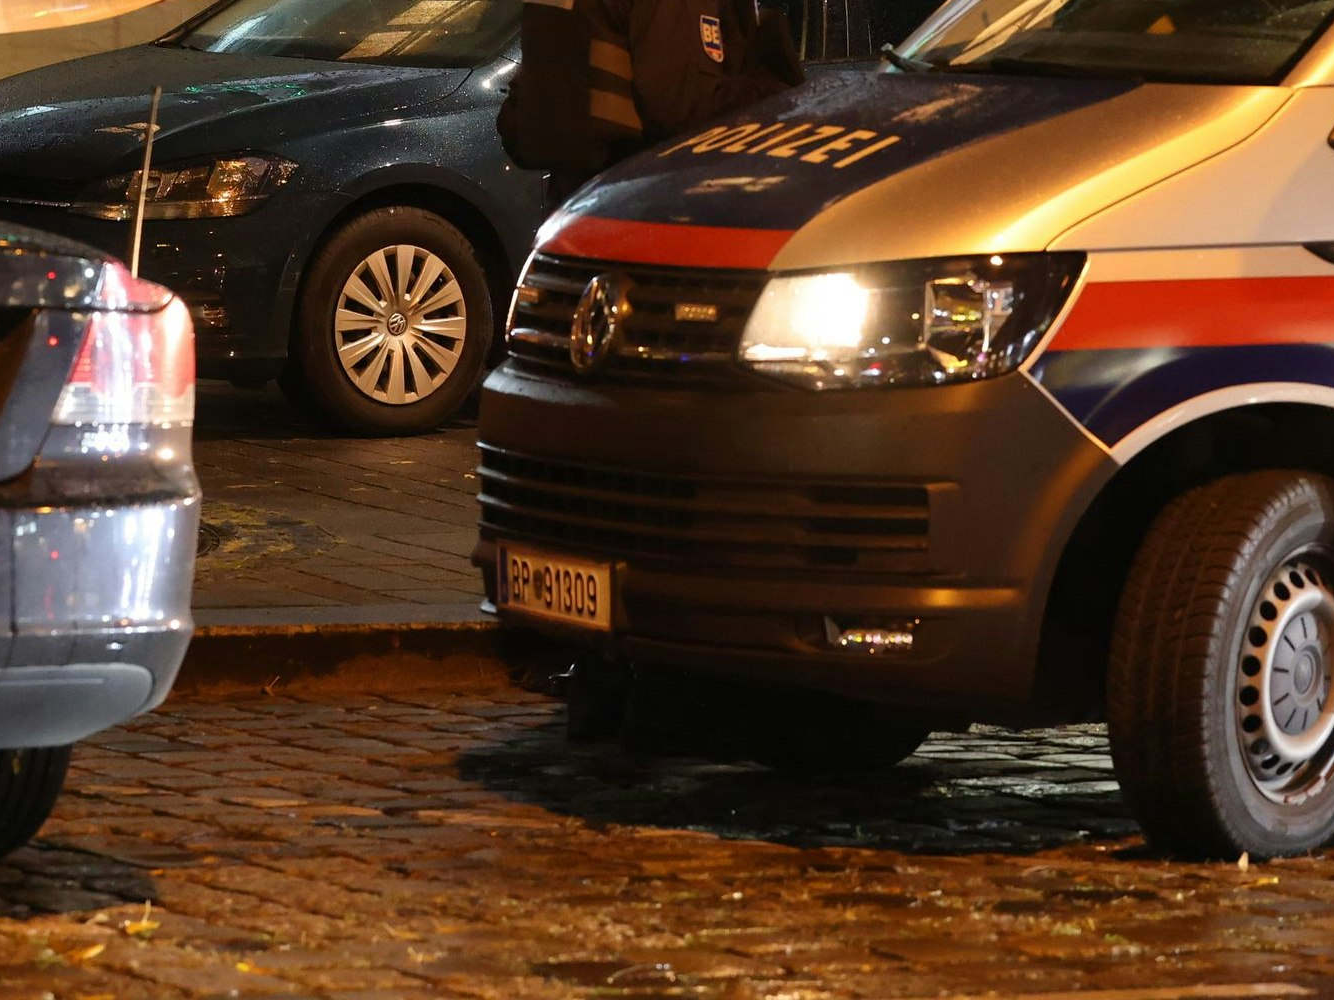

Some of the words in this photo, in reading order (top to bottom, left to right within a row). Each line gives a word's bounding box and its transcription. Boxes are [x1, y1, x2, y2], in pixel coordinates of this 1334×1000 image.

[702, 24, 721, 44] BE
[657, 122, 902, 169] POLIZEI
[511, 558, 531, 601] BP
[543, 565, 597, 617] 91309
